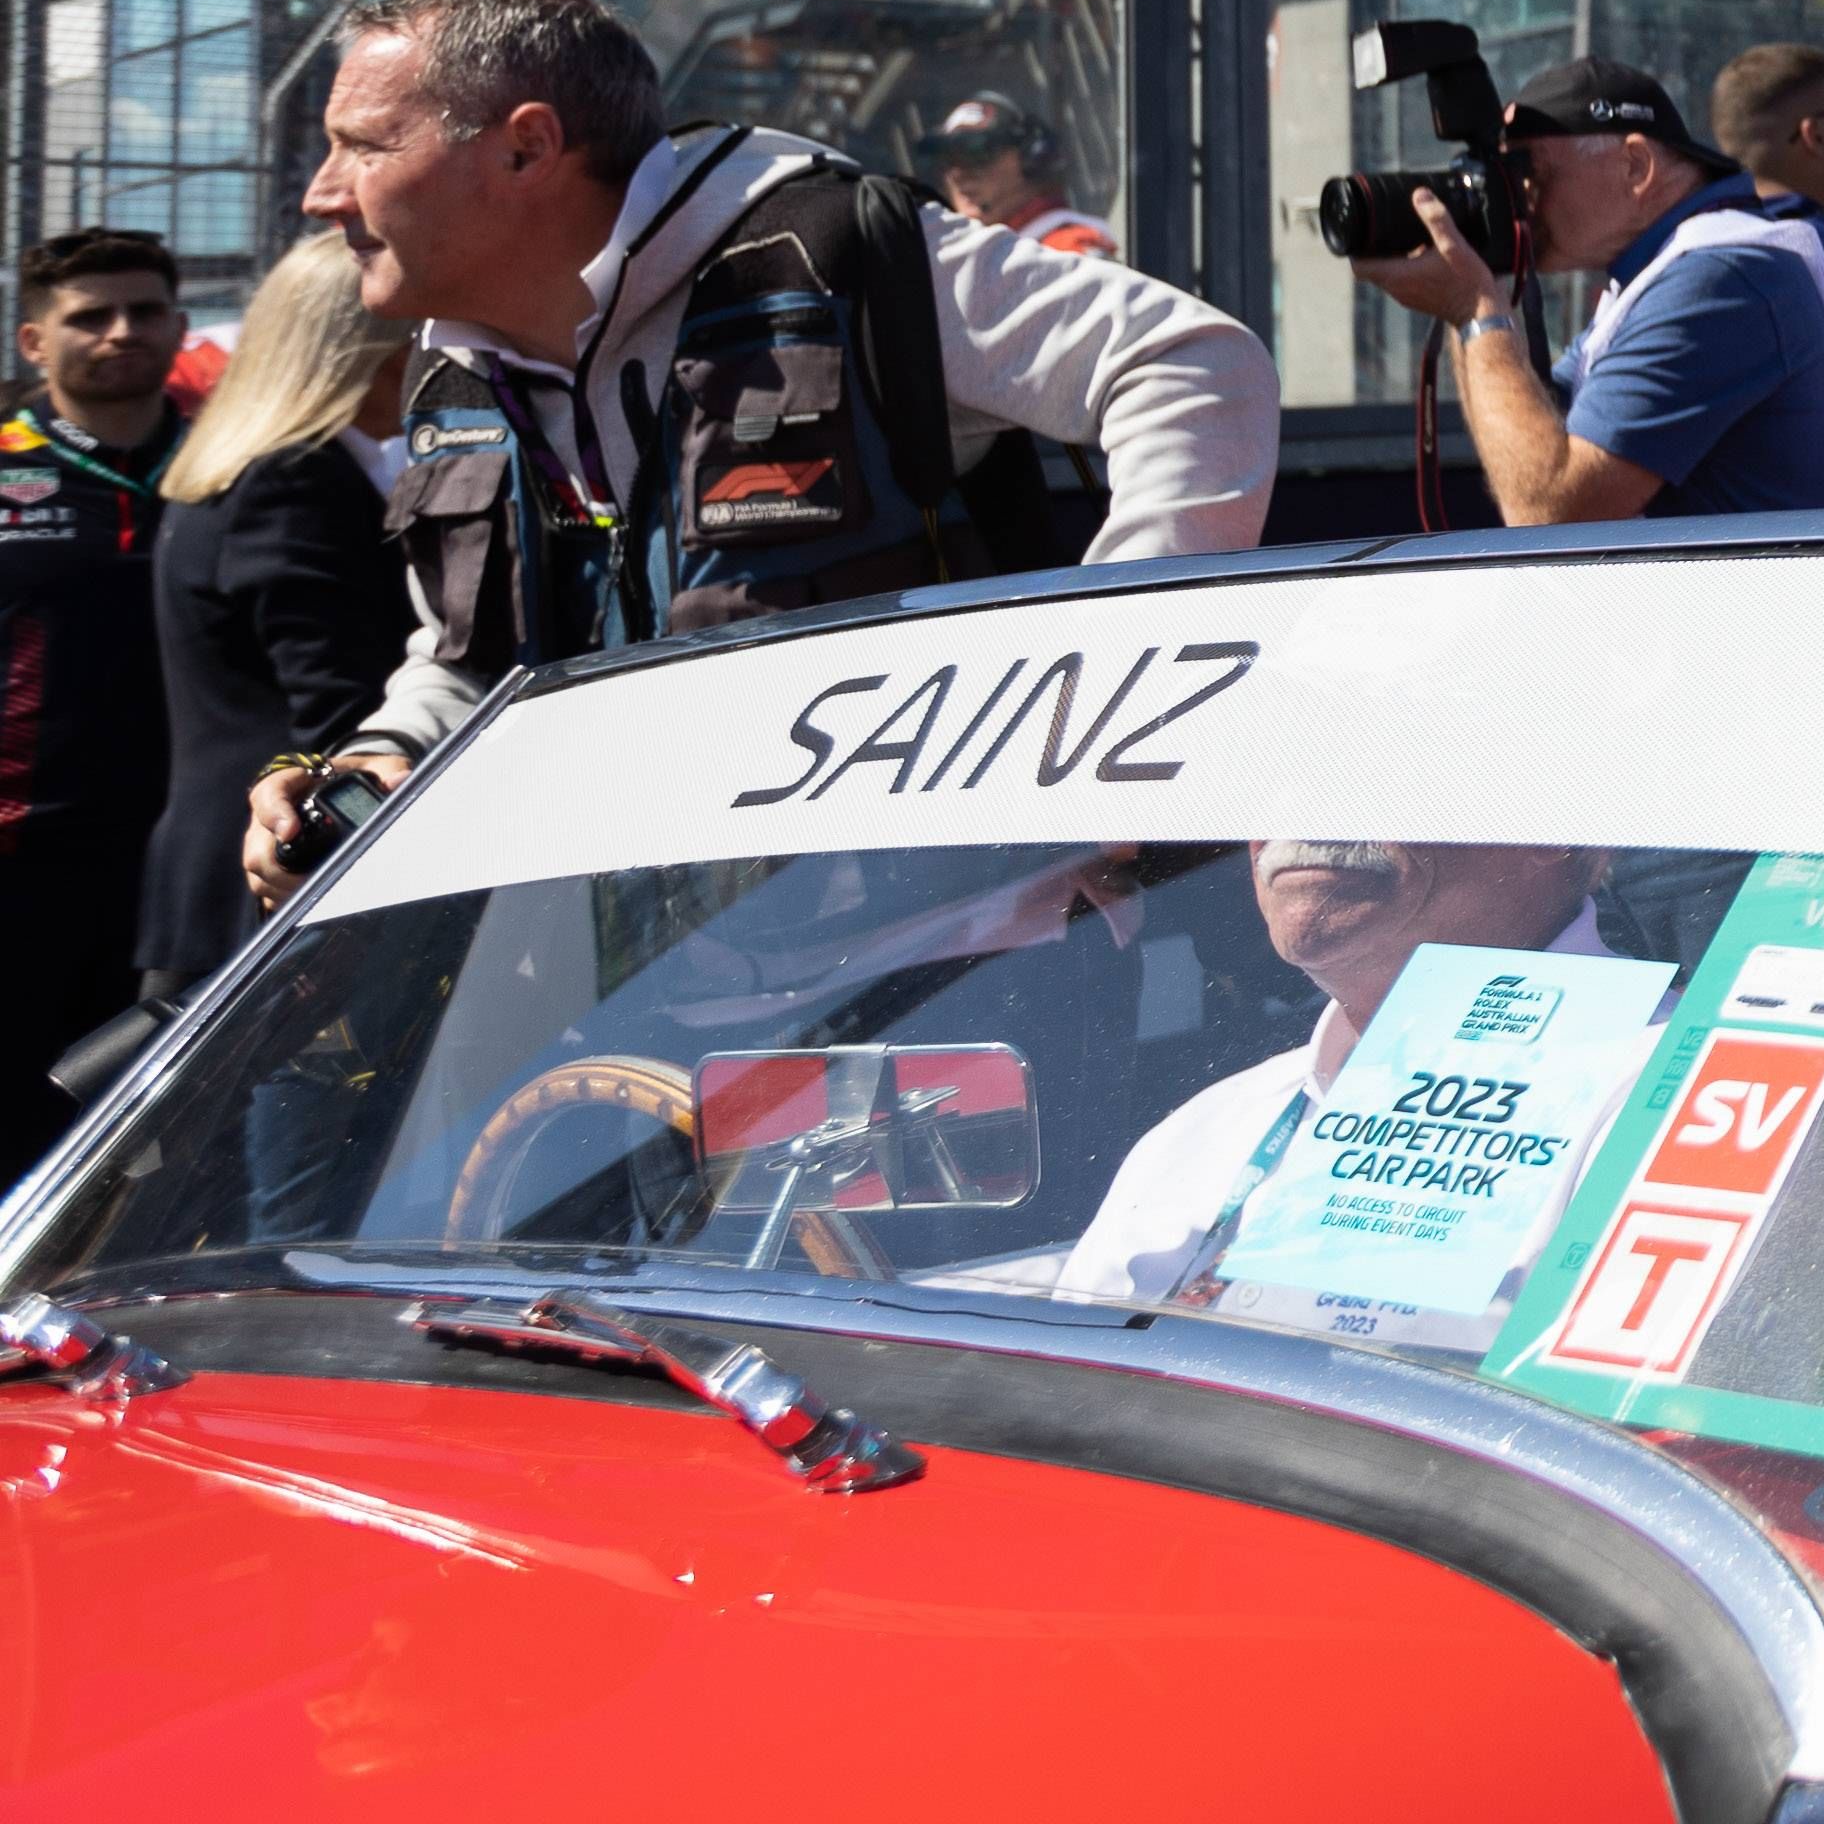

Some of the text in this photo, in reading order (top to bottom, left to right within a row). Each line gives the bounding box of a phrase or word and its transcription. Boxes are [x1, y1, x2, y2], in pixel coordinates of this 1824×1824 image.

[730, 640, 1261, 808] SAINZ
[1473, 998, 1512, 1009] ROLEX
[1479, 987, 1534, 1001] FORMULA
[1461, 1019, 1530, 1033] GRAND PRIX
[1467, 1009, 1543, 1024] AUSTRALIAN
[1392, 1071, 1531, 1123] 2023
[1675, 1079, 1808, 1153] SV
[1313, 1111, 1572, 1166] COMPETITORS'
[1331, 1149, 1509, 1198] CAR PARK
[1320, 1212, 1451, 1242] DURING EVENT DAYS
[1326, 1193, 1468, 1224] NO ACCESS TO CIRCUIT
[1620, 1236, 1712, 1330] T
